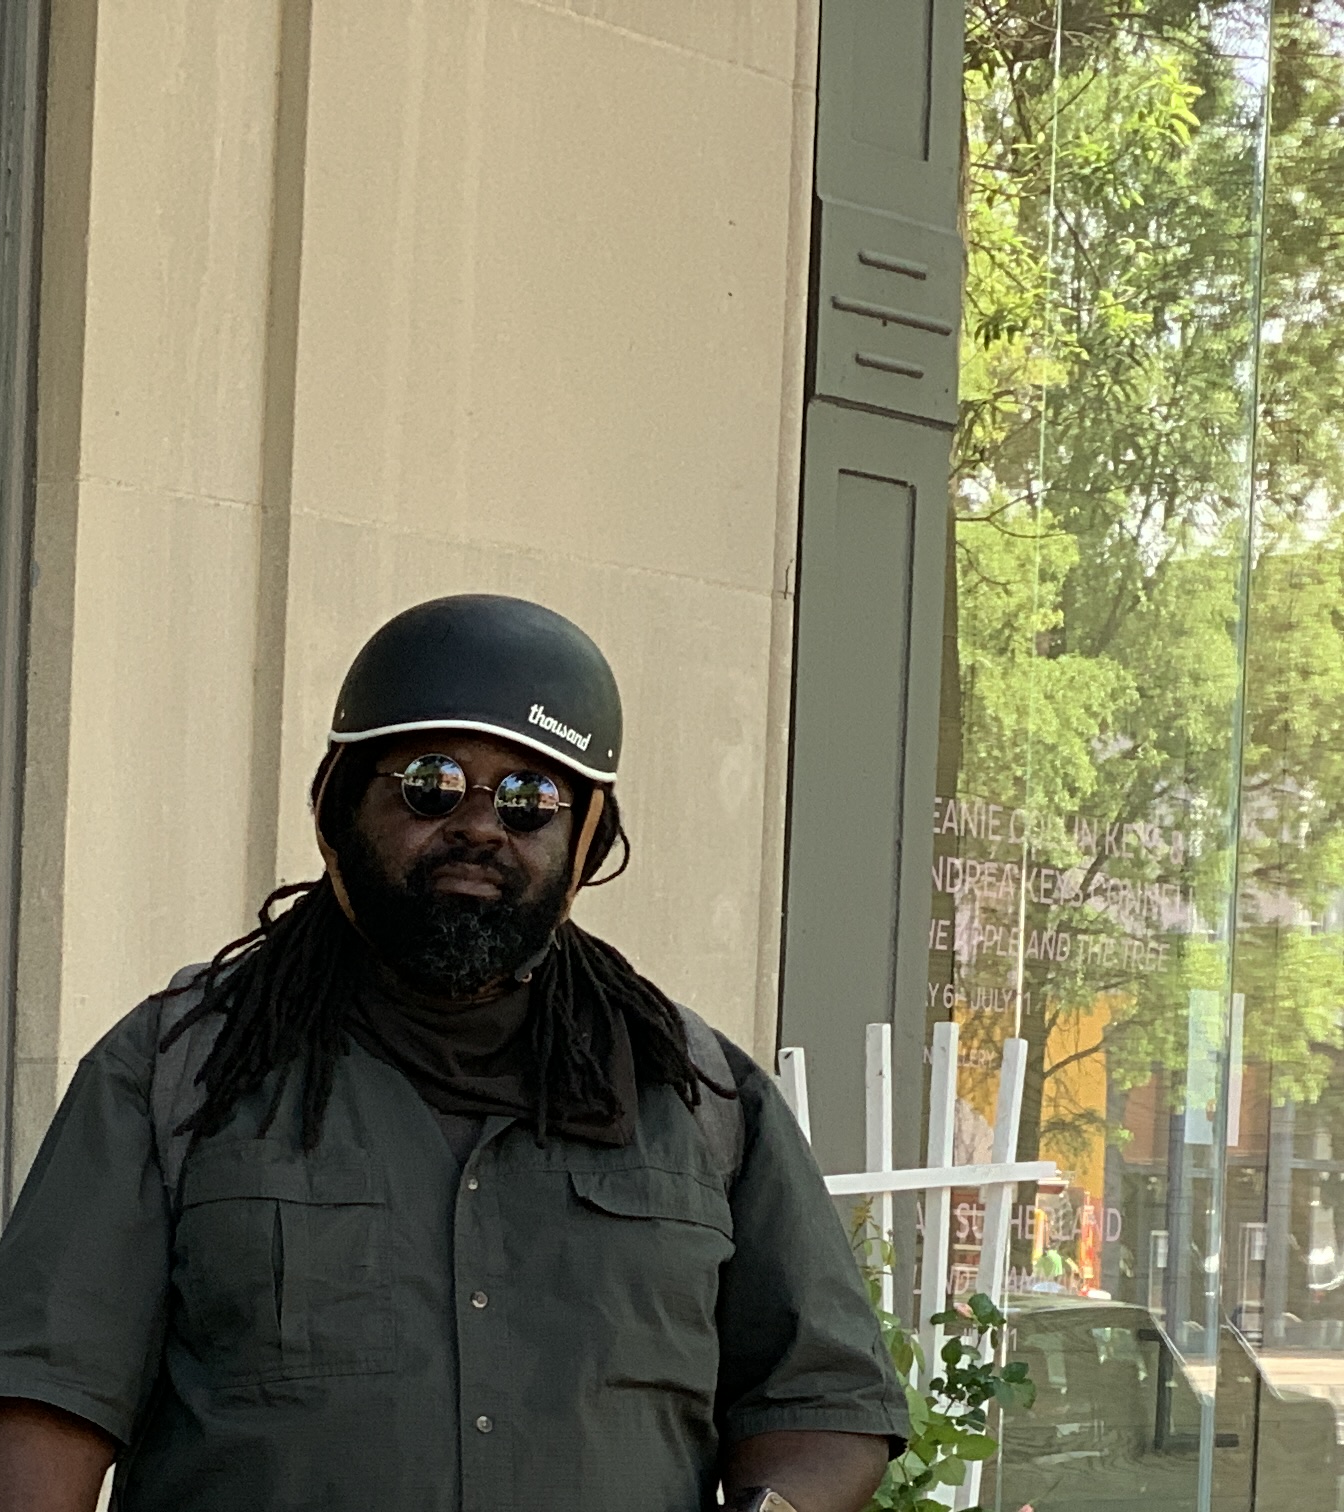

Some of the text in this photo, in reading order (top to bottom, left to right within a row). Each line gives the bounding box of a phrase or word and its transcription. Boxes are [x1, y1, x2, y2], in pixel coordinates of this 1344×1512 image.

[527, 703, 593, 752] thousand
[932, 798, 1003, 841] EANIE
[930, 855, 1018, 899] NDREA
[1025, 929, 1071, 962] AND
